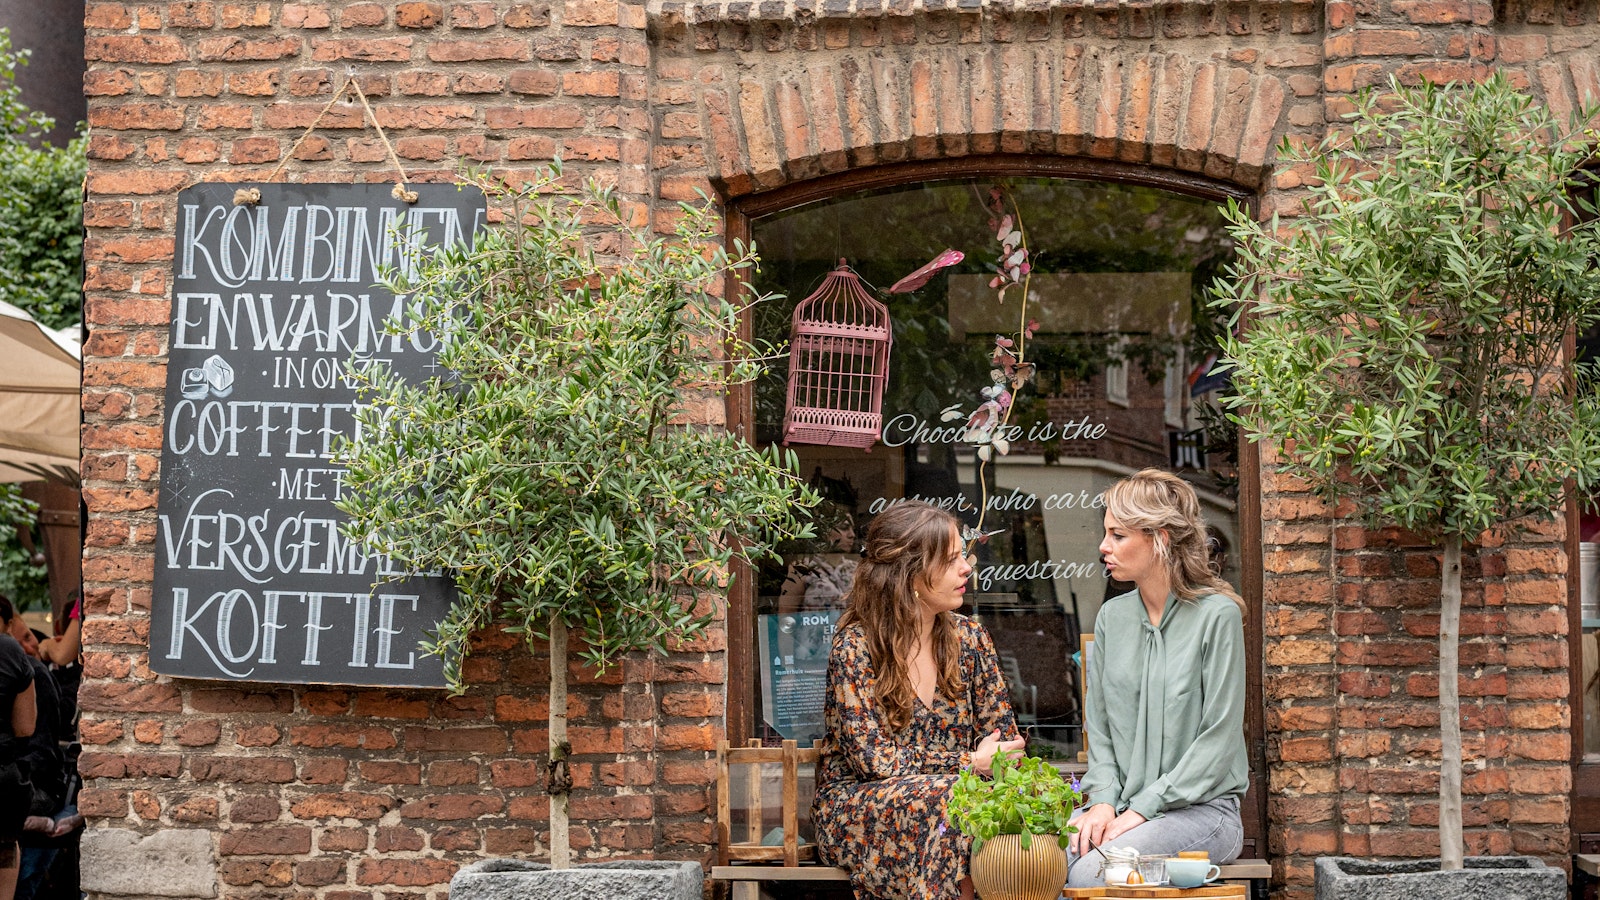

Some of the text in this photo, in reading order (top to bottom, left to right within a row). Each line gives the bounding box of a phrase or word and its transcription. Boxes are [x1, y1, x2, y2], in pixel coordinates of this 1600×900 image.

[273, 357, 306, 389] IN
[1028, 420, 1058, 442] is
[1062, 415, 1107, 441] the
[278, 468, 352, 500] MET
[986, 486, 1038, 512] who
[1043, 489, 1108, 510] care
[978, 559, 1097, 592] question
[165, 587, 420, 678] KOFFIE
[802, 615, 829, 626] ROM
